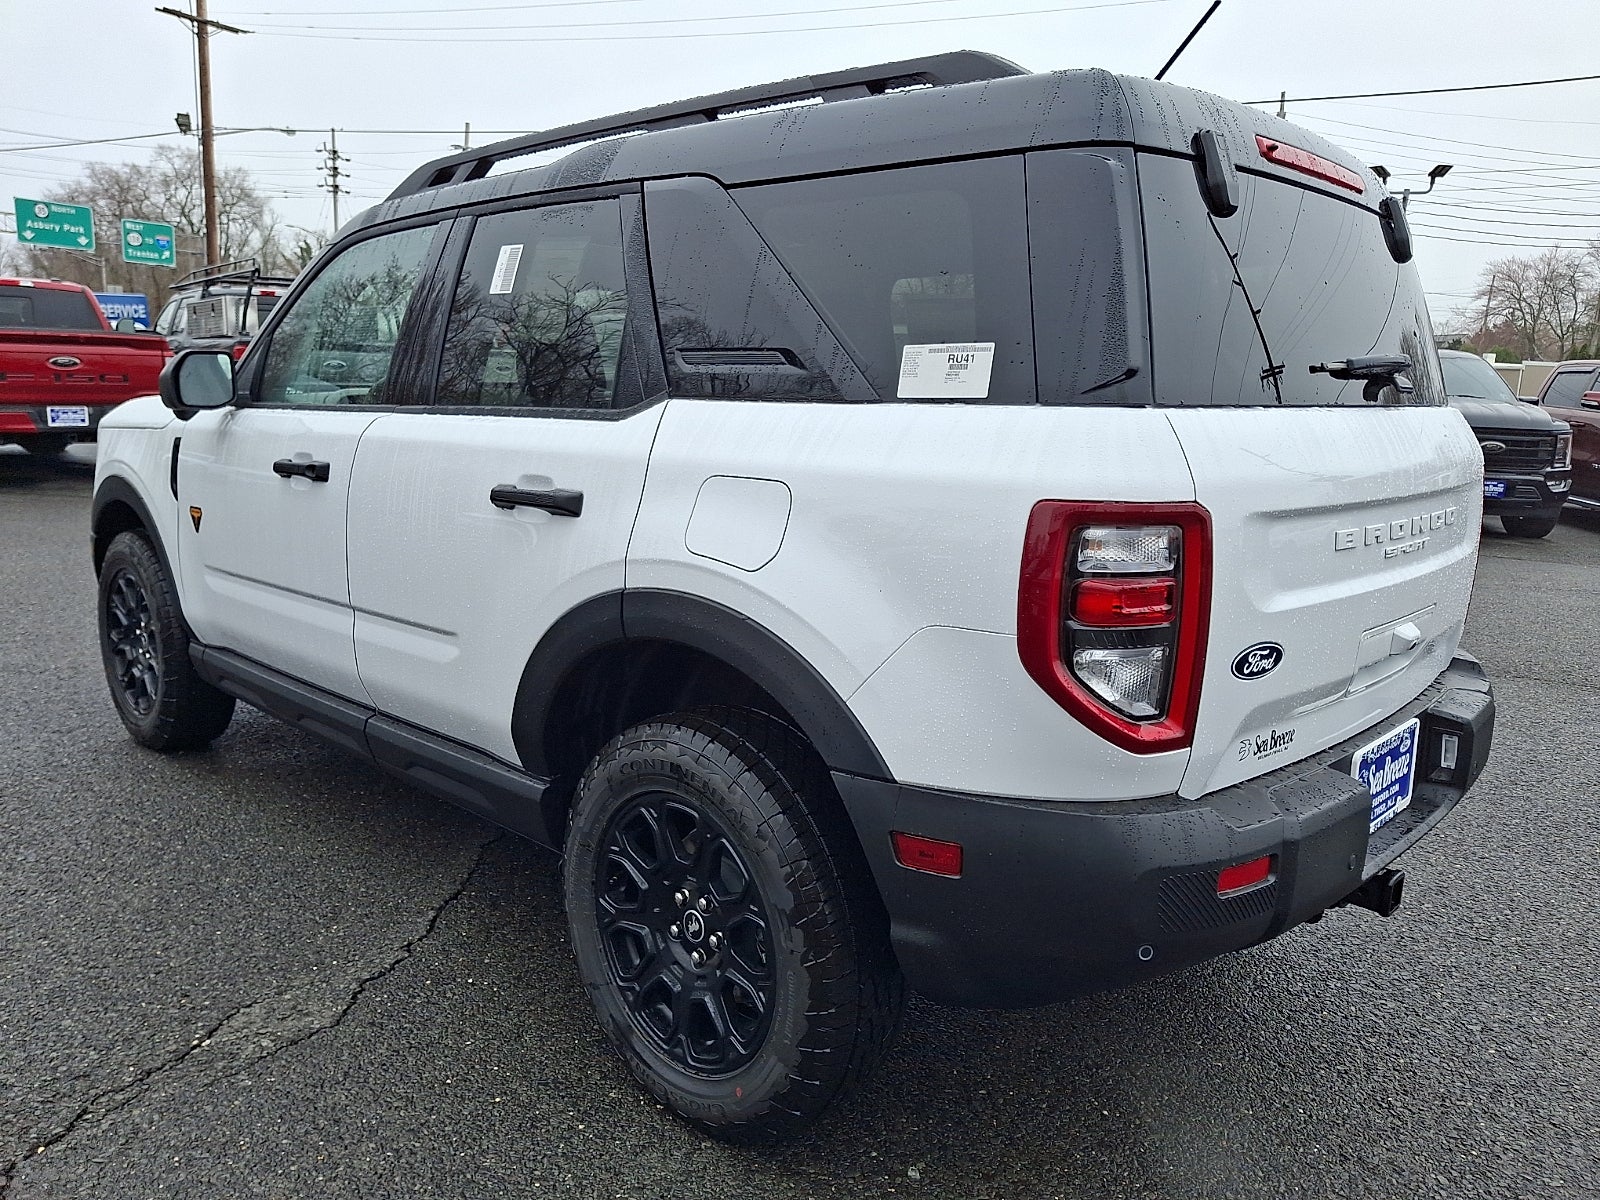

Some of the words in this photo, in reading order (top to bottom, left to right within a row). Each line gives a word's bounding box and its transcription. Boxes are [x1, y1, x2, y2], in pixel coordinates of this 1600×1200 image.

[50, 204, 76, 215] NORTH
[26, 219, 61, 233] Asbury
[63, 223, 85, 234] Park
[126, 221, 144, 231] WEST
[126, 248, 160, 260] Trenton
[100, 303, 147, 319] SERVICE
[947, 353, 975, 364] RU41
[1334, 506, 1457, 552] BRONCO
[1384, 536, 1431, 559] SPORT
[1243, 649, 1277, 675] Ford
[1253, 734, 1269, 757] Sea
[1269, 728, 1296, 751] Breeze
[1369, 763, 1384, 796] Sea
[1383, 752, 1410, 788] Breeze
